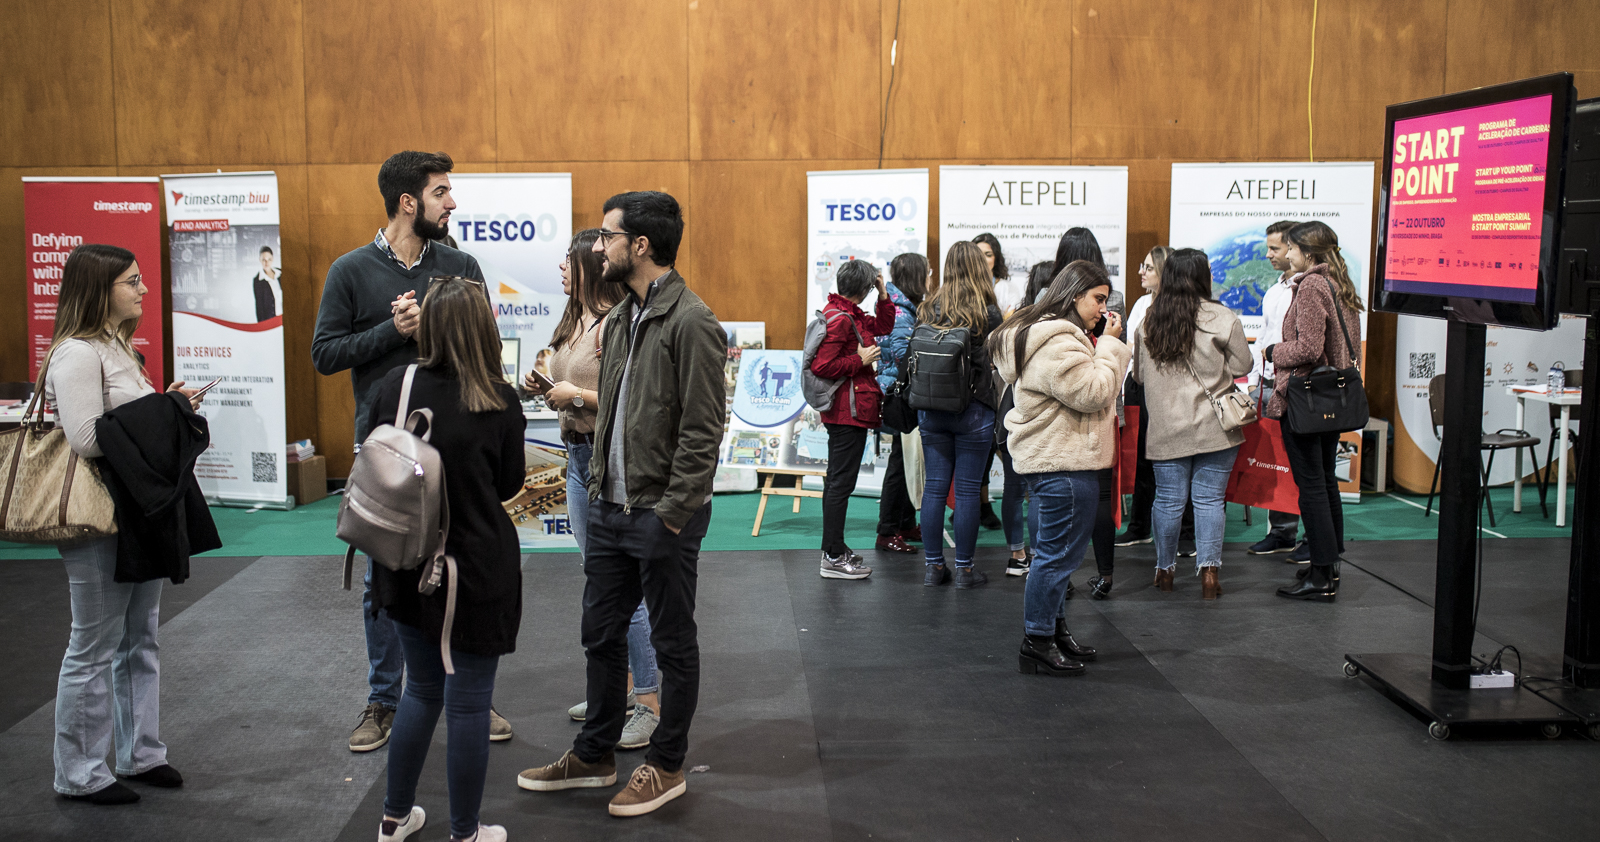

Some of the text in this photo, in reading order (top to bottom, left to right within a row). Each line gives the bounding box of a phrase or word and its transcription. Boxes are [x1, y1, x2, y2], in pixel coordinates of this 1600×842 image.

[1479, 118, 1516, 131] PROGRAMA DE
[1478, 128, 1512, 141] ACELERAÇÃO
[1513, 128, 1520, 136] DE
[1394, 126, 1465, 164] START
[1476, 168, 1492, 177] START
[1493, 167, 1500, 175] UP
[1501, 166, 1515, 174] YOUR
[1516, 164, 1533, 173] POINT
[1393, 163, 1459, 196] POINT
[983, 181, 1086, 205] ATEPELI
[1226, 180, 1315, 199] ATEPELI
[94, 200, 152, 213] timestamp
[826, 203, 896, 221] TESCO
[1392, 219, 1398, 228] 14
[1406, 218, 1413, 228] 22
[1414, 218, 1445, 228] OUTUBRO
[1495, 212, 1531, 221] EMPRESARIAL
[174, 221, 228, 230] BI AND ANALYTICS
[458, 220, 535, 242] TESCO
[33, 250, 71, 266] comp
[33, 267, 63, 279] with
[498, 303, 550, 316] Metals
[177, 346, 232, 358] OUR SERVICES
[772, 396, 791, 405] Team
[1256, 461, 1289, 473] timestamp
